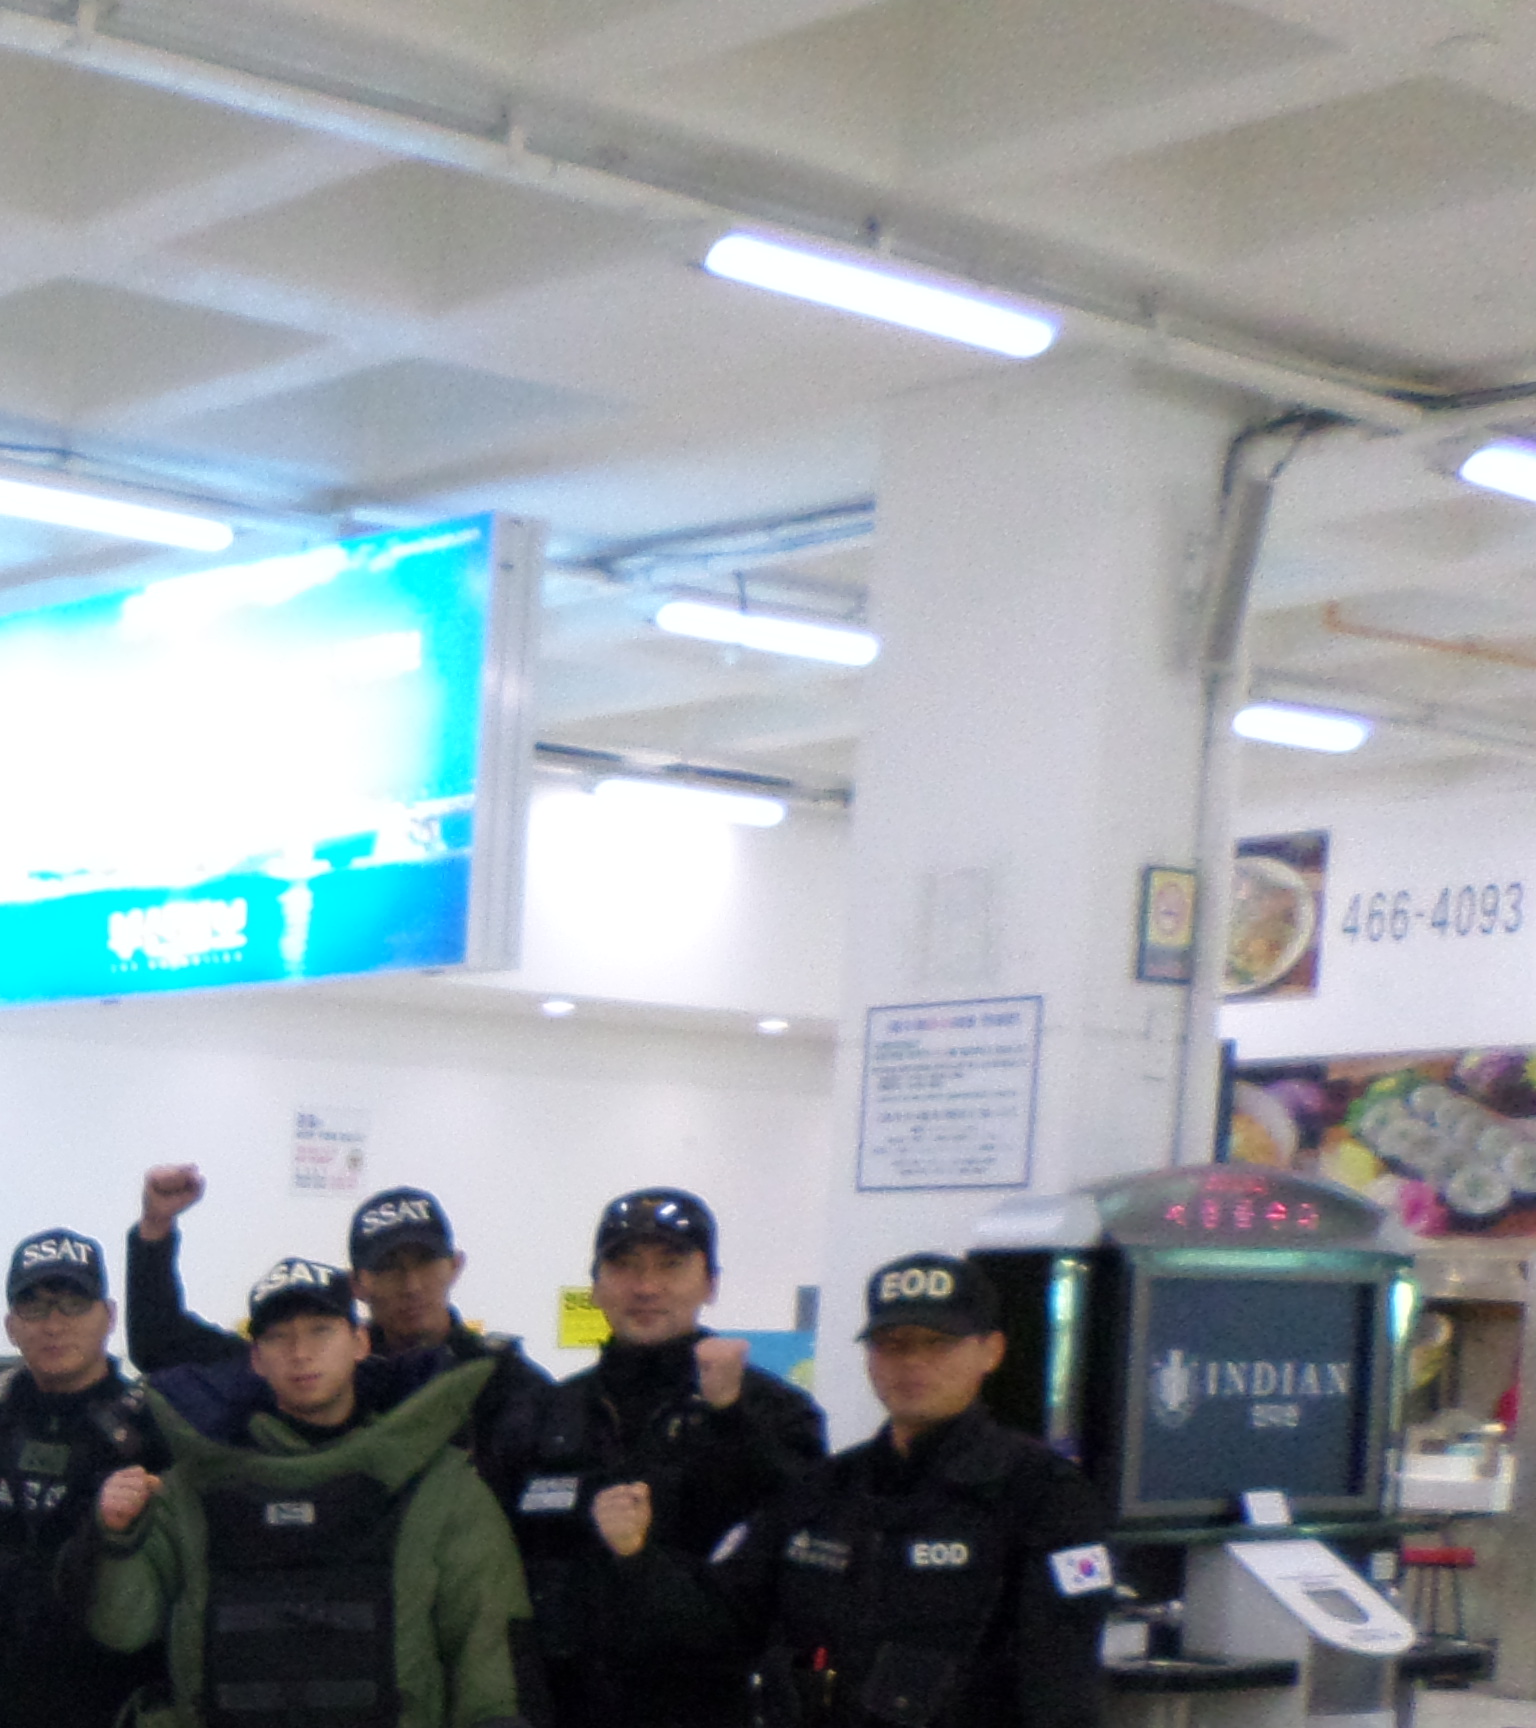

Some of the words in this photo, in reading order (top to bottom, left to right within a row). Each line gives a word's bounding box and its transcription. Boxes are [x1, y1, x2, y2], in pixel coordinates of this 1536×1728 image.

[1342, 882, 1524, 942] 466-4093
[362, 1199, 432, 1235] SSAT
[23, 1238, 94, 1269] SSAT
[880, 1268, 955, 1299] EOD
[1205, 1360, 1350, 1396] INDIAN
[912, 1542, 970, 1566] EOD
